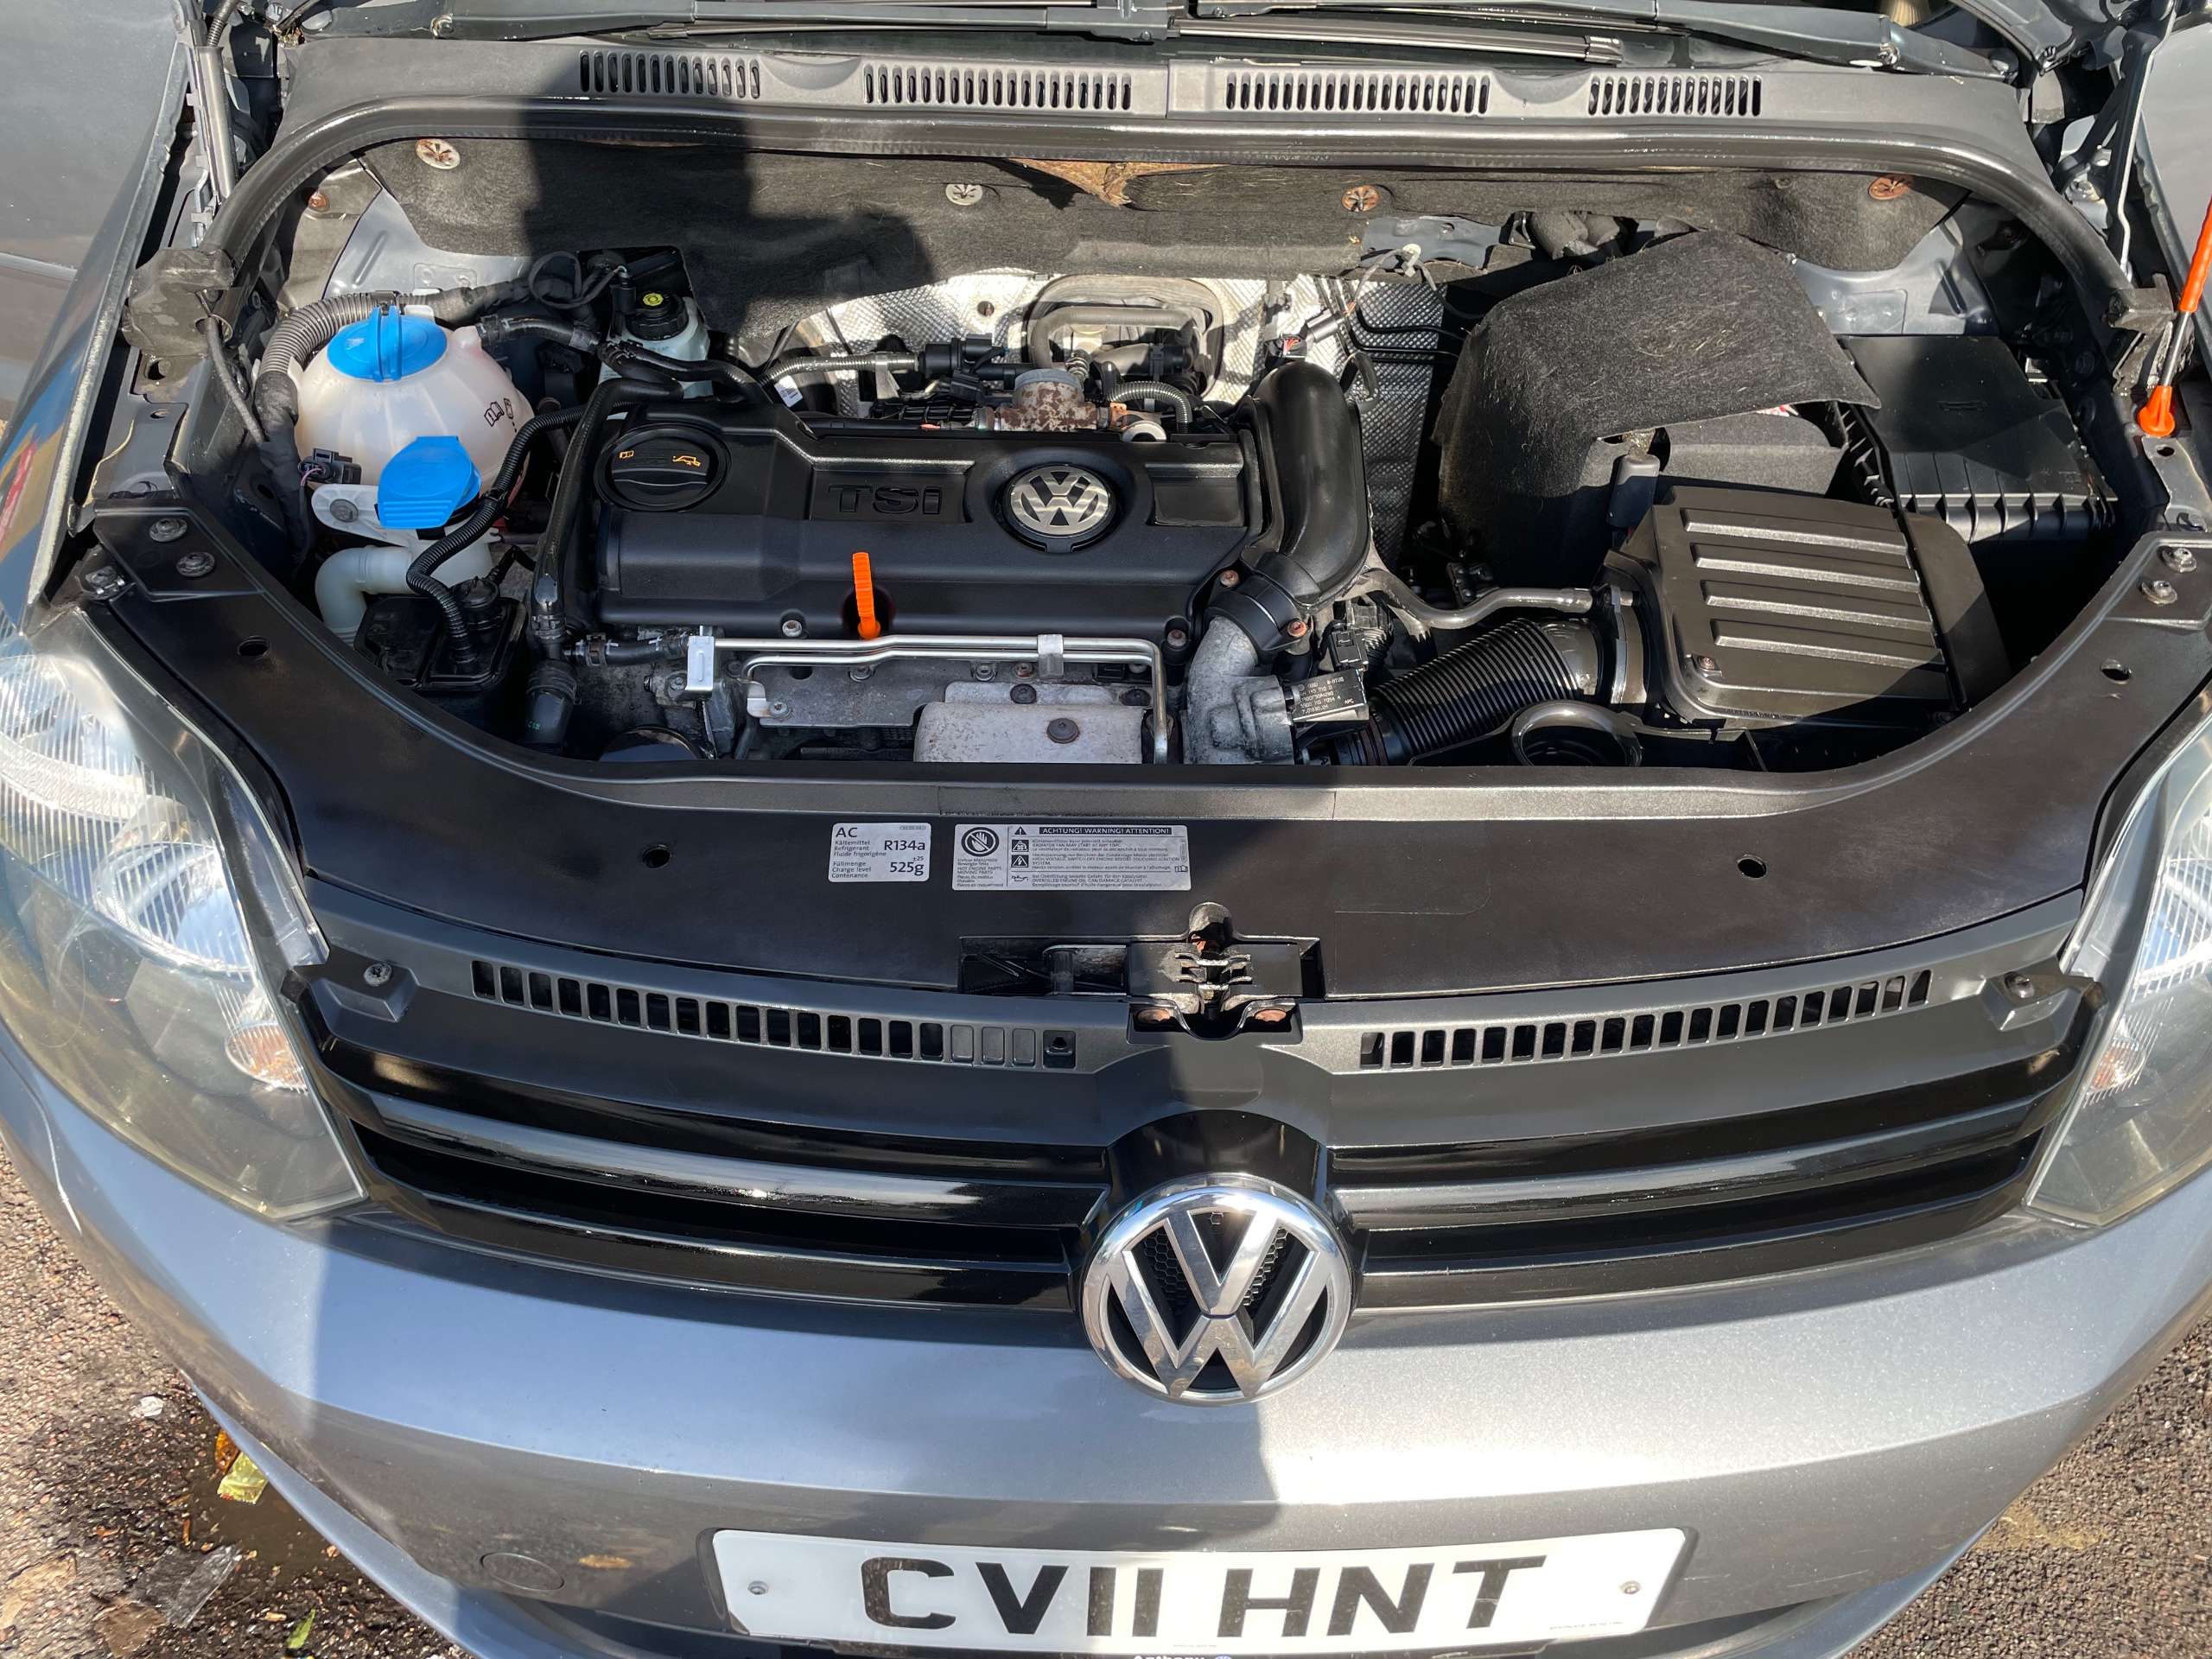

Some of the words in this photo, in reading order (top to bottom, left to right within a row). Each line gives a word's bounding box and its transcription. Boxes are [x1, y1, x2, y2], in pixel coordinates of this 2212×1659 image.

[835, 827, 858, 838] AC
[884, 840, 925, 851] R134a
[890, 862, 925, 876] 525g
[861, 1556, 1164, 1637] CV11
[1216, 1554, 1548, 1637] HNT
